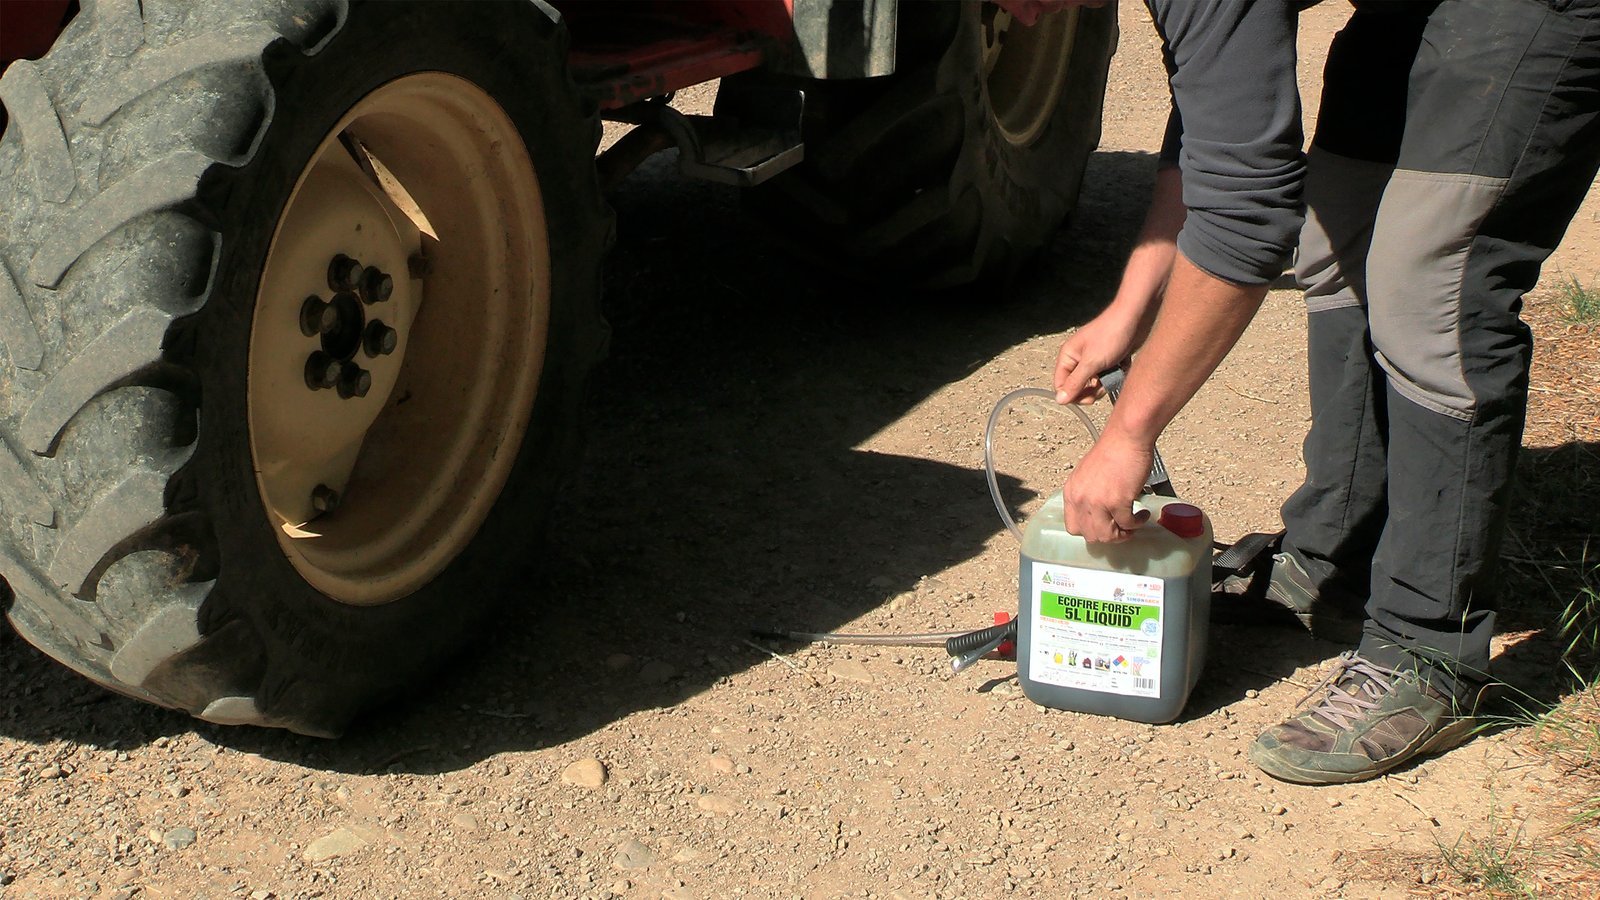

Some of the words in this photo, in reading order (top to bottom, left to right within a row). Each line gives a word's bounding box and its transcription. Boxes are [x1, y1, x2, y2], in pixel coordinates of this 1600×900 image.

[1053, 580, 1075, 588] FOREST
[1058, 596, 1099, 611] ECOFIRE
[1102, 602, 1141, 616] FOREST
[1065, 607, 1081, 621] 5L
[1086, 610, 1132, 627] LIQUID
